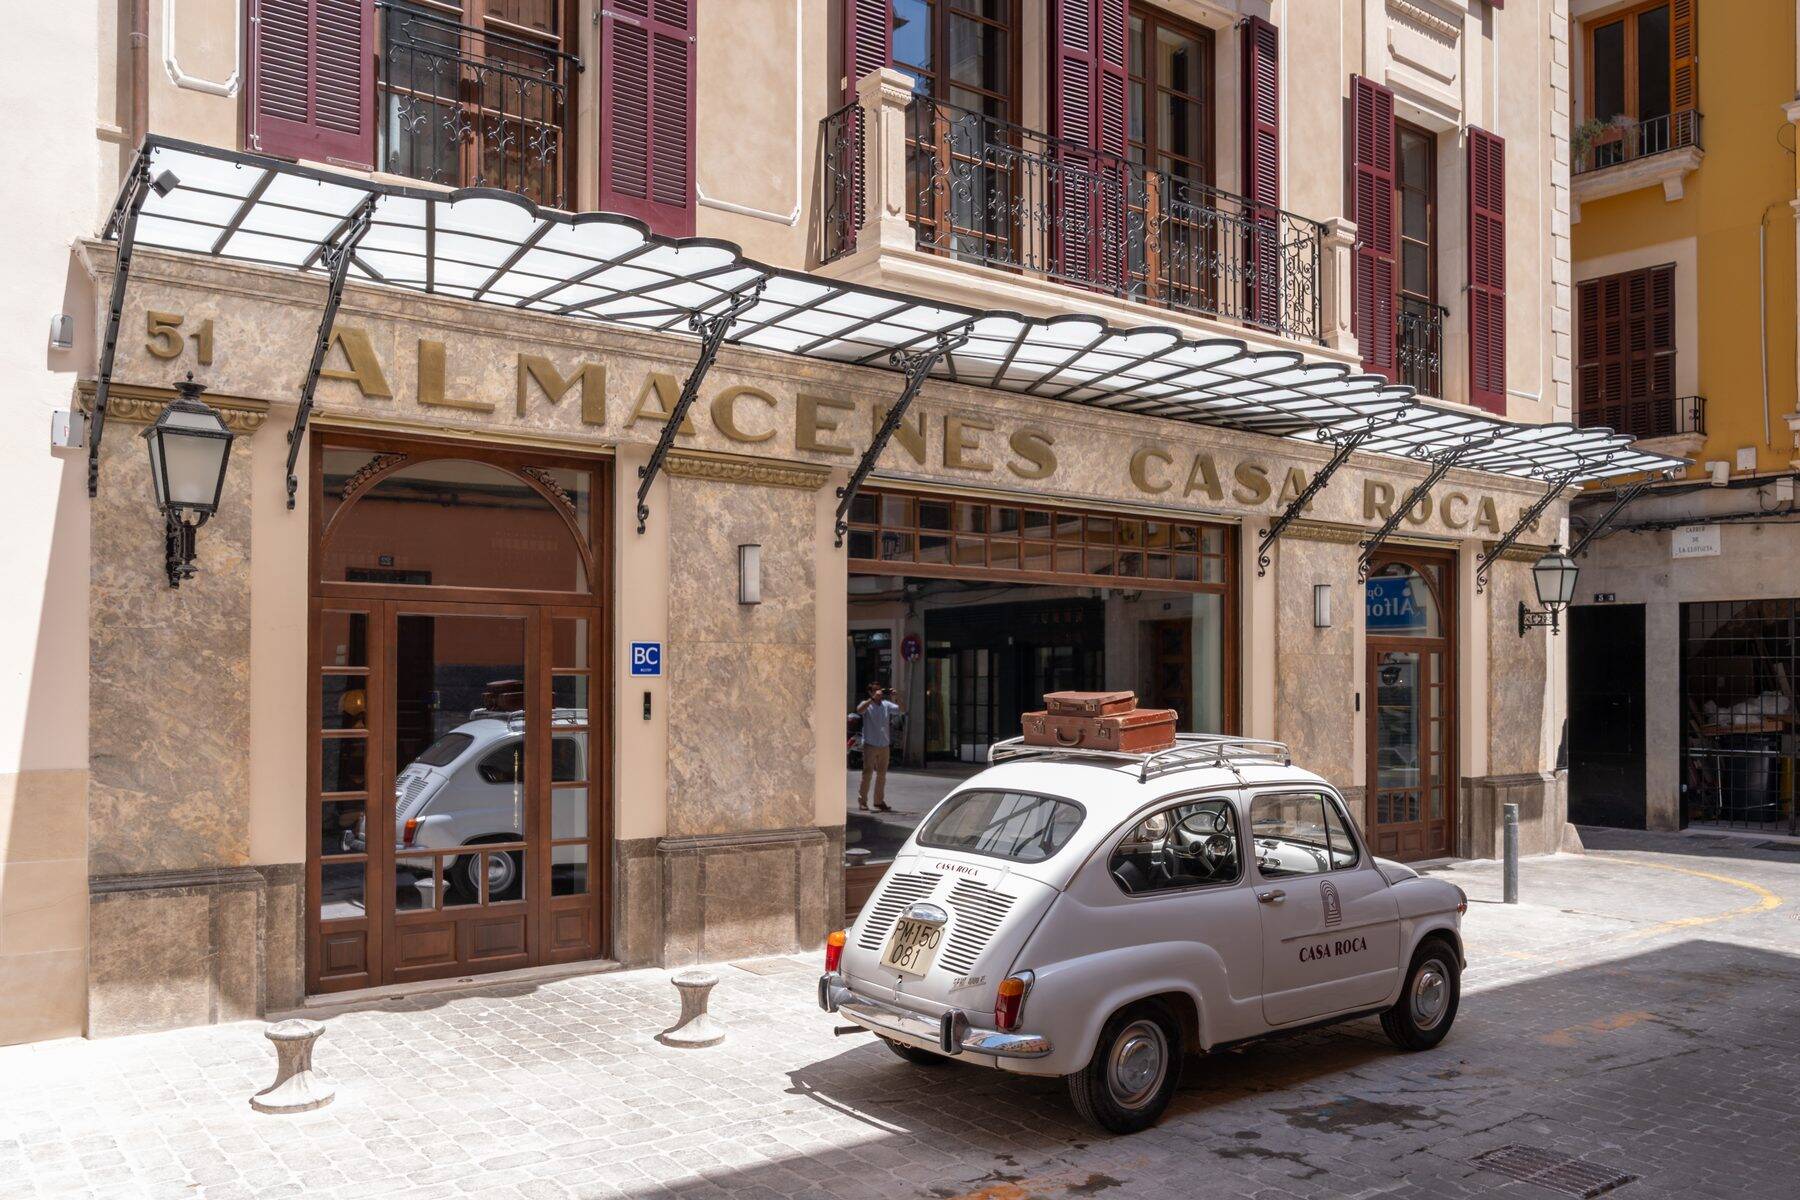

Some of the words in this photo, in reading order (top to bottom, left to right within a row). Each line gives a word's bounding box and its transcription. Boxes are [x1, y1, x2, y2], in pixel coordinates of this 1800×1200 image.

[145, 310, 214, 366] 51
[299, 324, 1058, 480] ALMACENES
[1129, 447, 1314, 512] CASA
[1363, 478, 1501, 534] ROCA
[634, 646, 658, 665] BC
[935, 862, 955, 871] CASA
[956, 865, 978, 877] ROCA
[891, 944, 921, 970] 081
[1299, 944, 1332, 963] CASA
[1335, 936, 1367, 957] ROCA
